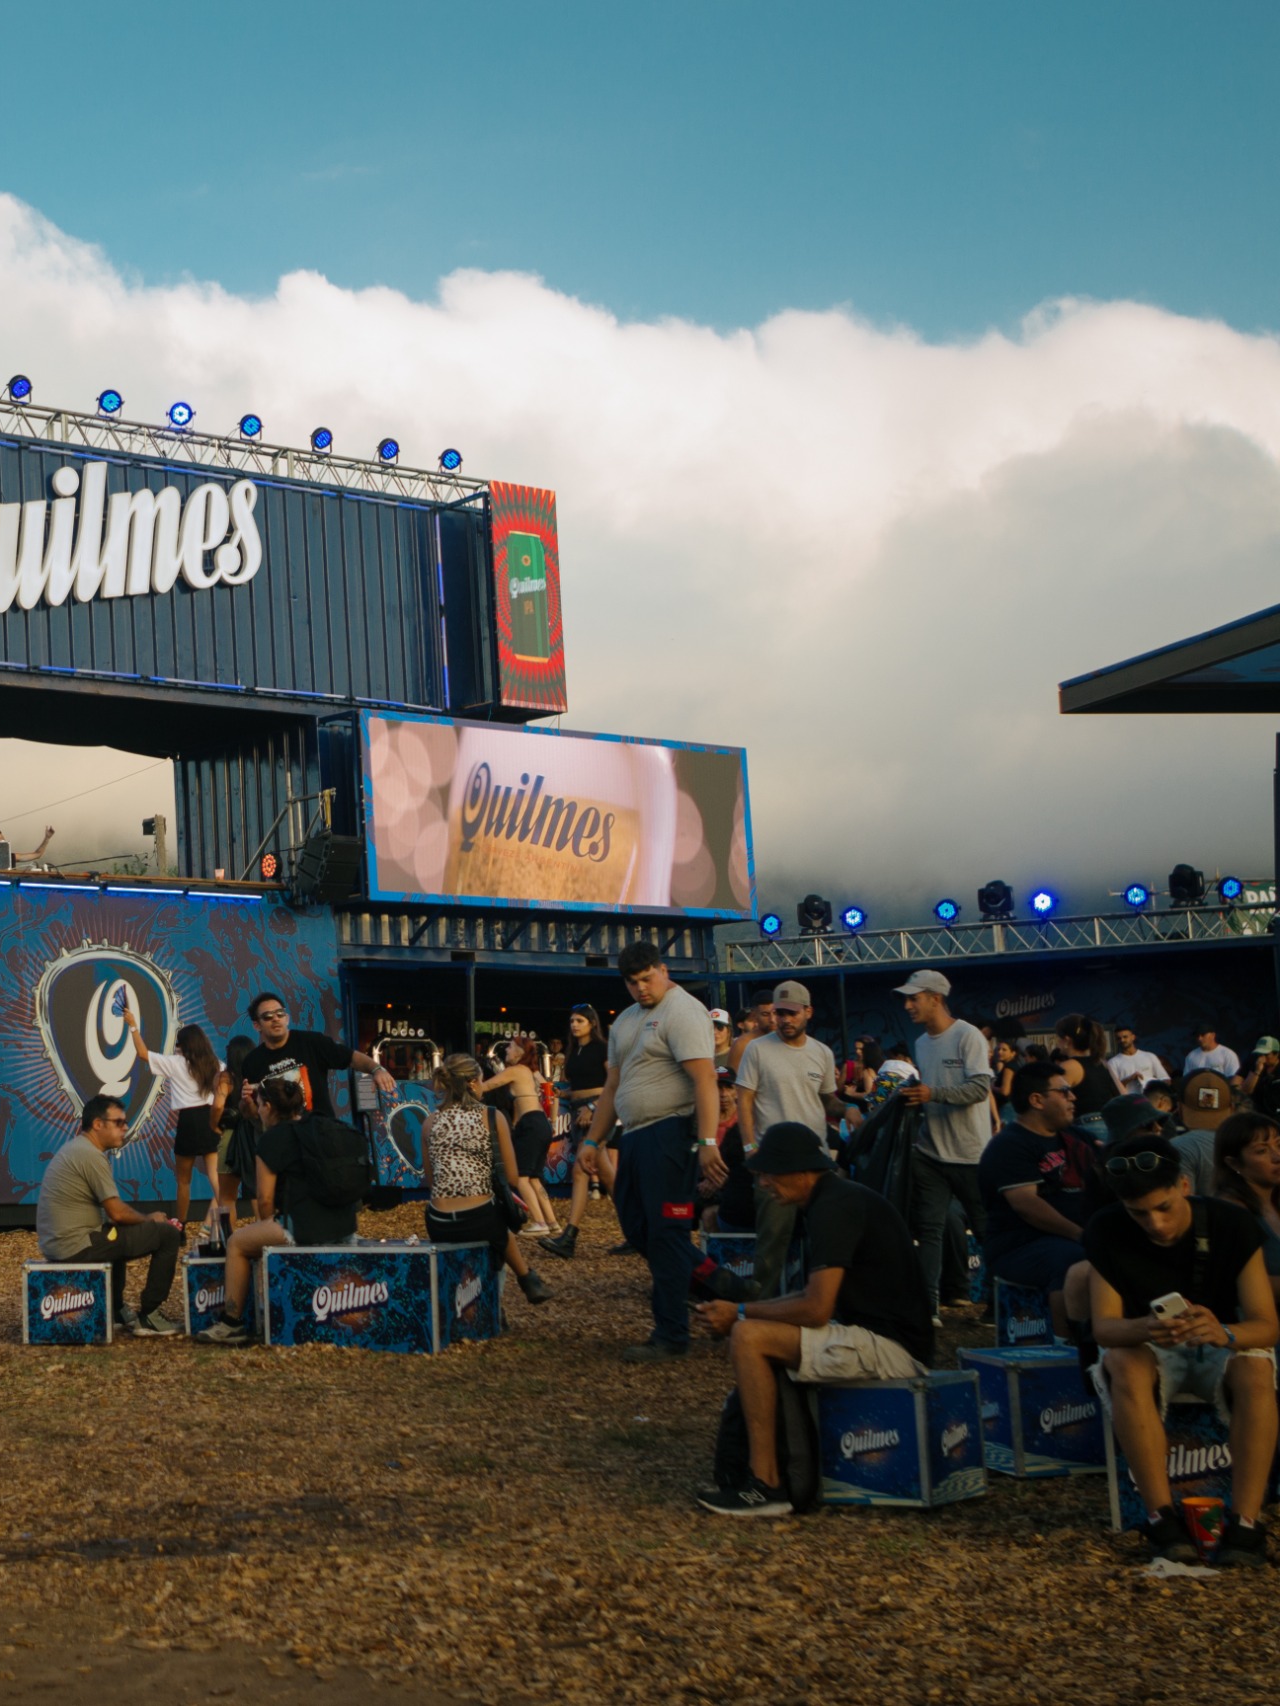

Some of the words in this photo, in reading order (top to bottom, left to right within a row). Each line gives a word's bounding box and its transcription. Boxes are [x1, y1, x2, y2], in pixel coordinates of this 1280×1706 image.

[509, 576, 547, 599] Quilmes
[460, 762, 615, 863] Quilmes
[995, 991, 1055, 1019] Quilmes
[41, 1290, 95, 1320] Quilmes
[195, 1285, 224, 1313] Quil
[312, 1281, 389, 1322] Quilmes
[1007, 1315, 1047, 1343] Quilmes
[1040, 1402, 1096, 1433] Quilmes
[841, 1428, 900, 1459] Quilmes
[1165, 1442, 1232, 1478] ilmes
